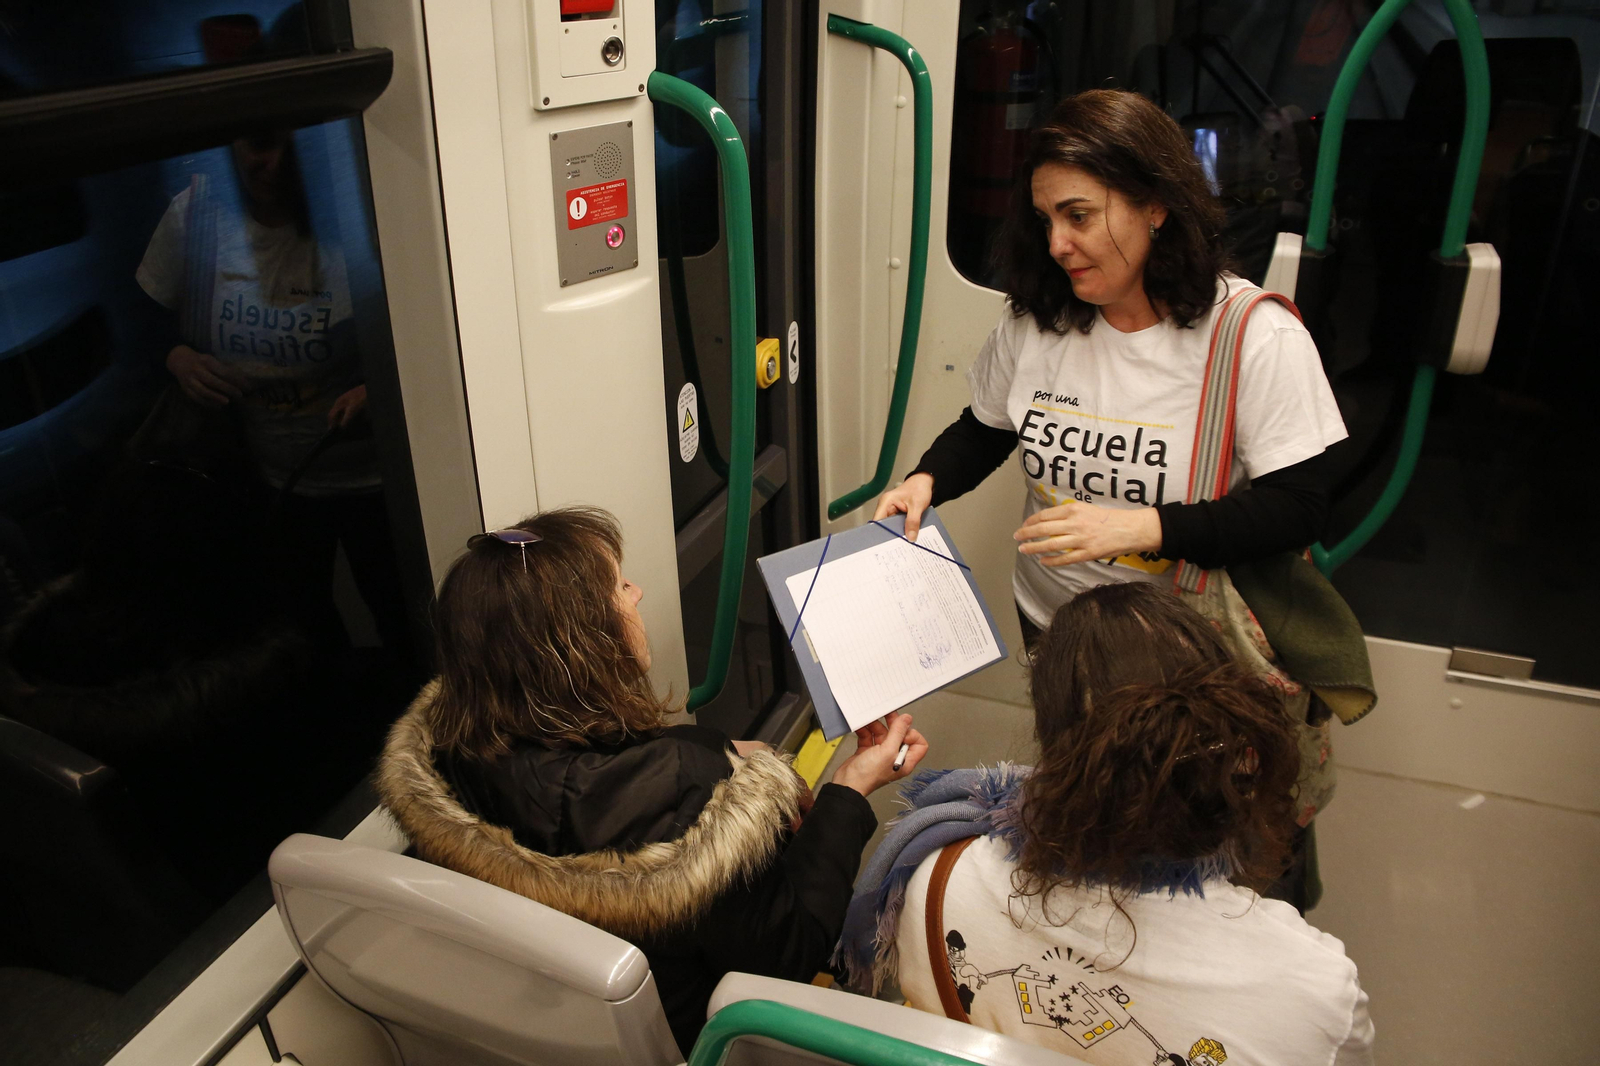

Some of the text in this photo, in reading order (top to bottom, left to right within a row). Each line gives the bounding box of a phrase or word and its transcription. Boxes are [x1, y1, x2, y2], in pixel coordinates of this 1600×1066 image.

[1033, 390, 1080, 407] por una
[1019, 409, 1168, 468] Escuela
[1022, 448, 1167, 506] Oficial
[1074, 490, 1093, 504] de
